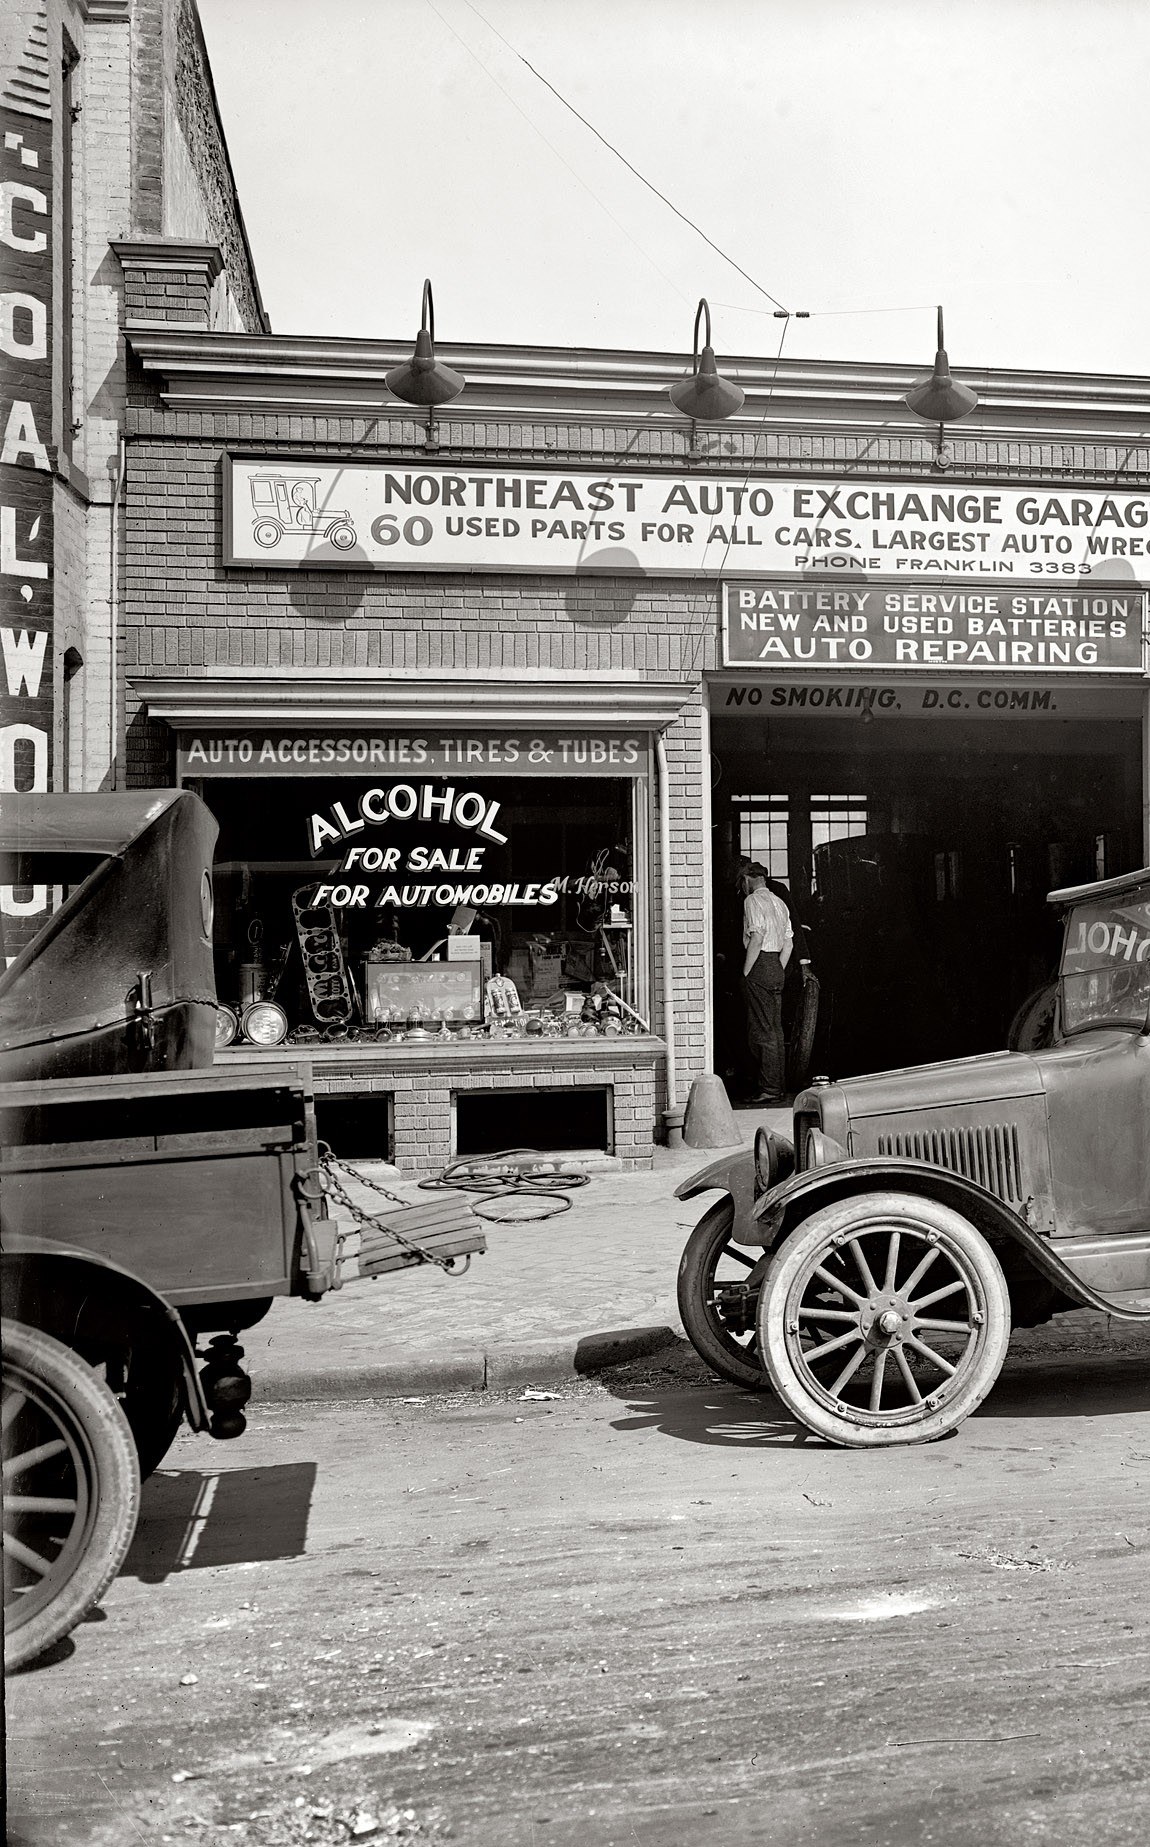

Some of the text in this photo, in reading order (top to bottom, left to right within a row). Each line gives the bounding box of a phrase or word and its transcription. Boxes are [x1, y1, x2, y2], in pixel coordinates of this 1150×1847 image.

[385, 474, 643, 513] NORTHEAST
[661, 485, 773, 517] AUTO
[794, 489, 1002, 524] EXCHANGE
[371, 514, 433, 546] 60
[446, 517, 520, 538] USED
[532, 519, 625, 541] PARTS
[642, 523, 694, 543] FOR
[706, 525, 762, 546] ALL
[775, 527, 862, 549] CARS.
[873, 530, 990, 552] LARGEST
[1001, 534, 1072, 554] AUTO
[795, 556, 1092, 574] PHONE FRANKLIN 3383
[739, 590, 1128, 617] BATTERY SERVICE STATION
[741, 613, 1127, 638] NEW AND USED BATTERIES
[759, 637, 1098, 664] AUTO REPAIRING
[726, 687, 763, 706] NO
[977, 690, 1057, 711] COMM.
[187, 739, 253, 763] AUTO
[440, 740, 520, 763] TIRES
[528, 740, 554, 763] &
[558, 739, 640, 763] TUBES
[308, 785, 508, 855] ALCOHOL
[341, 847, 485, 872] FOR SALE
[310, 884, 558, 908] FOR AUTOMOBILES
